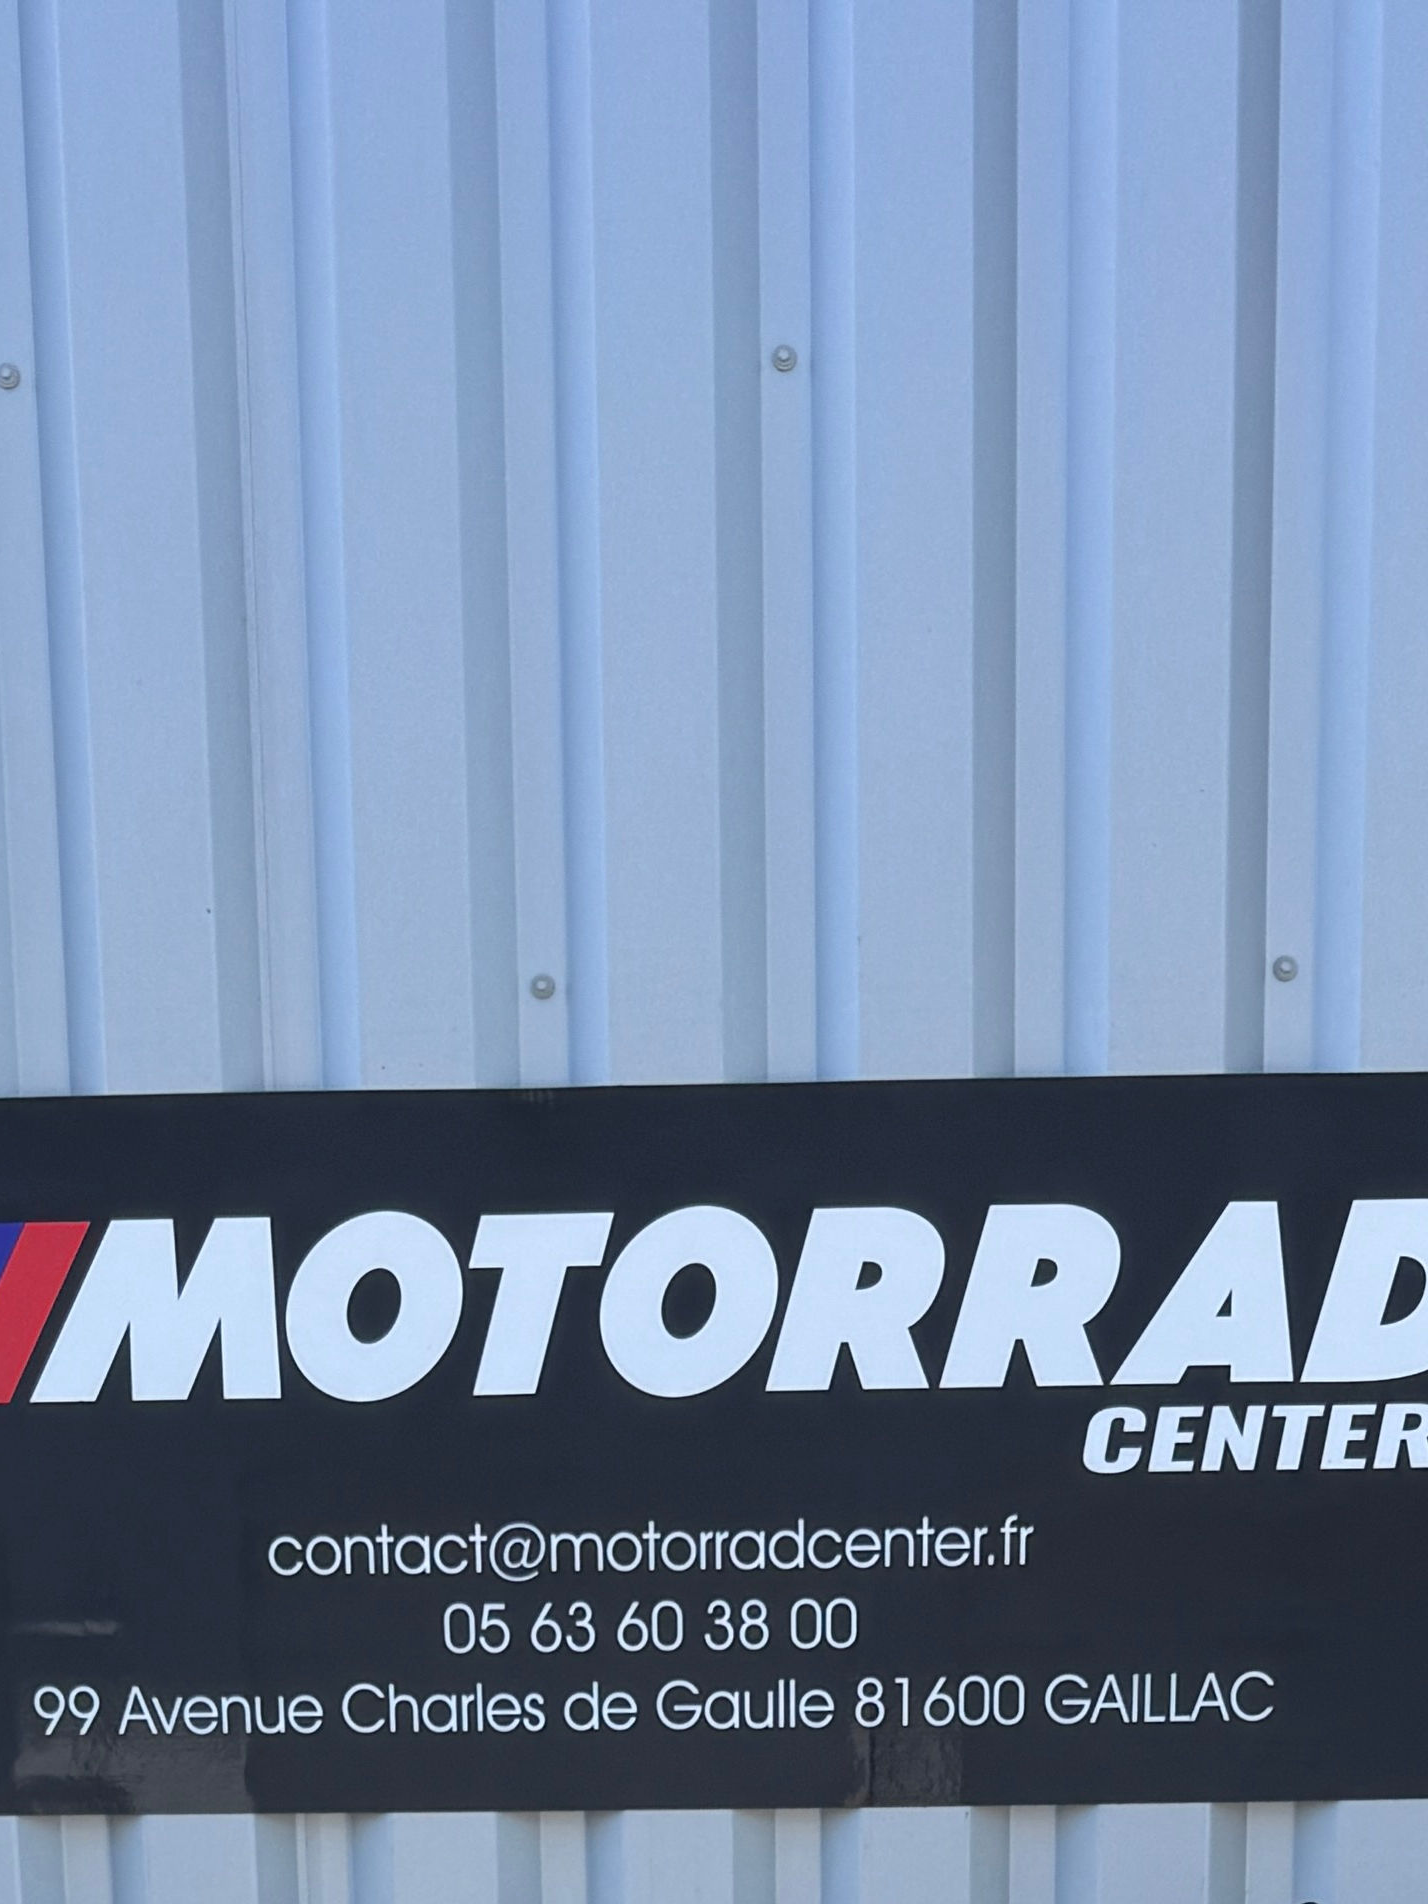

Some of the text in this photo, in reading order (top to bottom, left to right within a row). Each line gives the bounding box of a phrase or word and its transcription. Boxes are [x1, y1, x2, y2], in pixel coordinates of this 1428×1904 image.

[269, 1515, 1034, 1581] contact@motorradcenter.fr
[444, 1598, 857, 1653] 05 63 60 38 00
[34, 1671, 1274, 1735] 99 Avenue Charles de Gaulle 81600 GAILLAC
